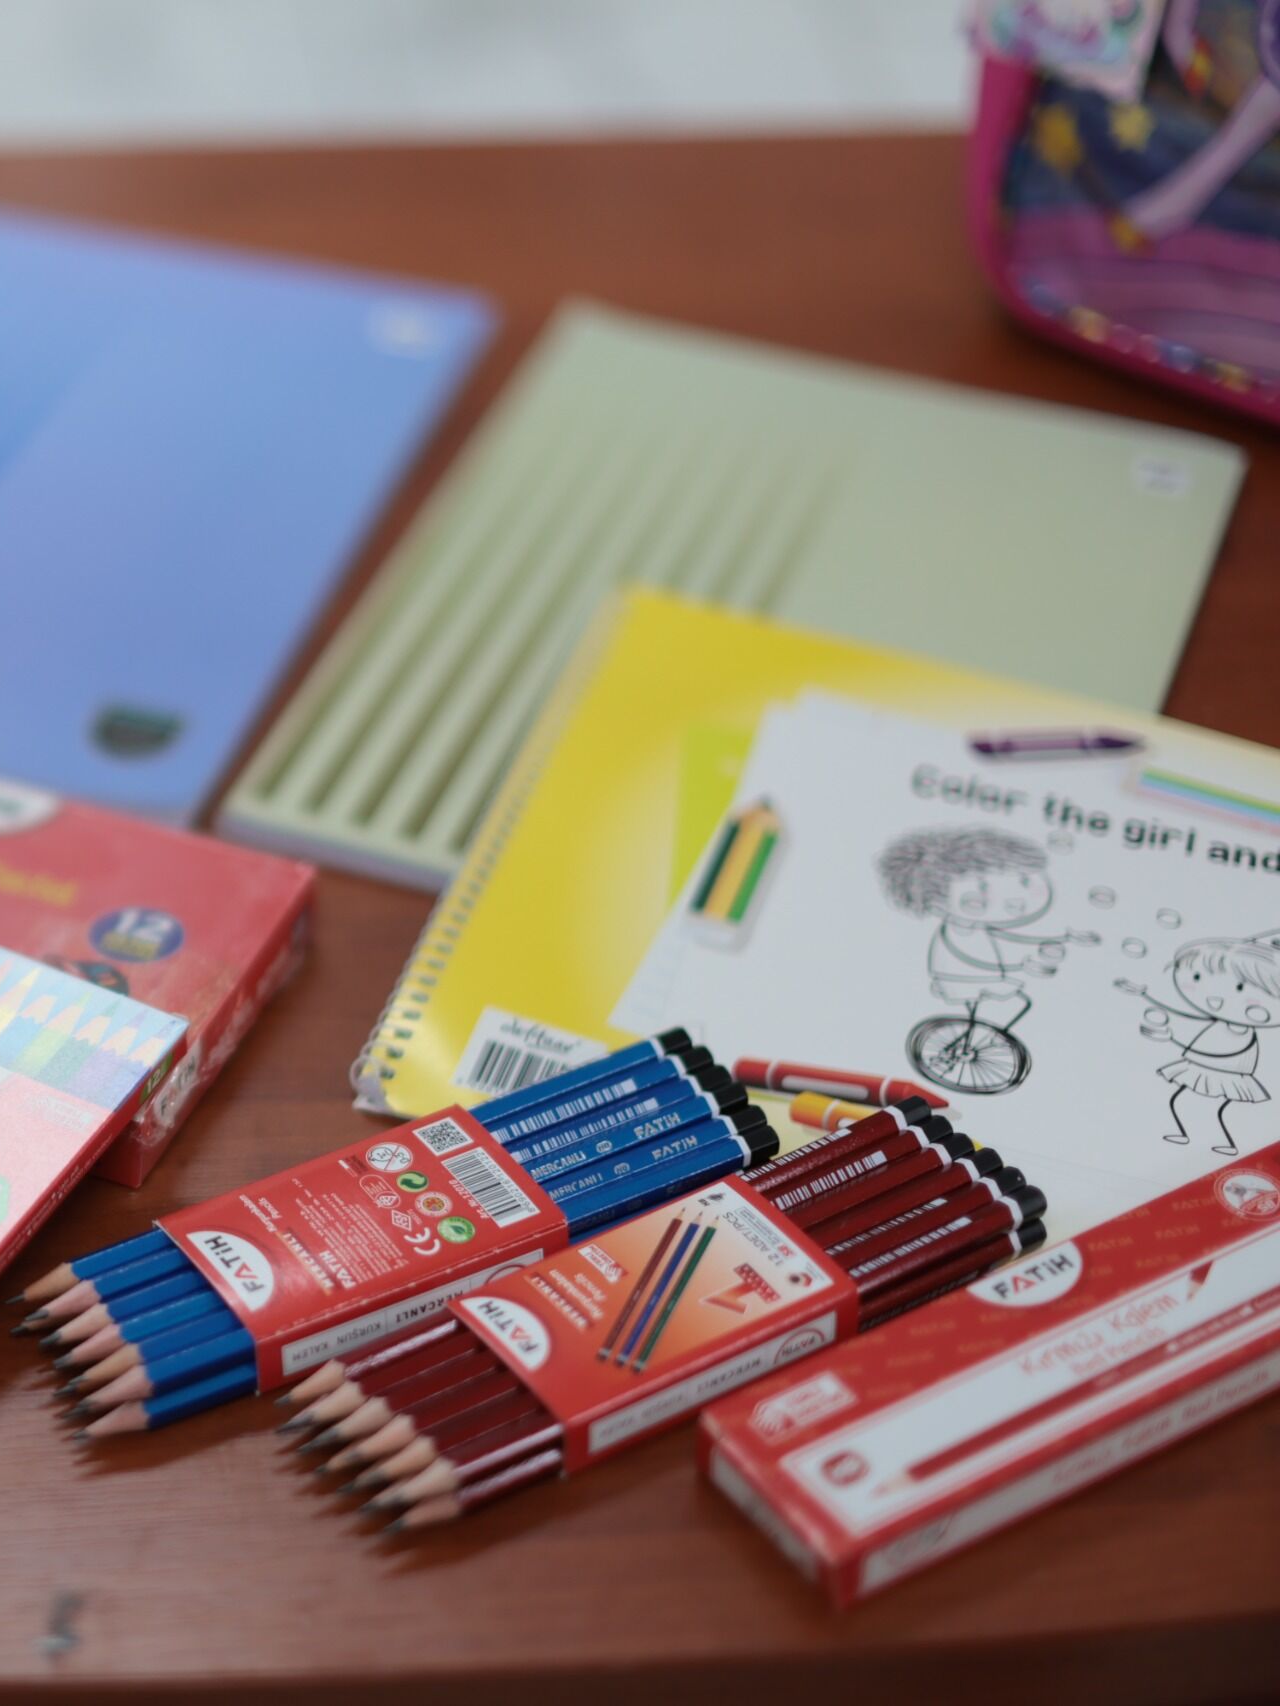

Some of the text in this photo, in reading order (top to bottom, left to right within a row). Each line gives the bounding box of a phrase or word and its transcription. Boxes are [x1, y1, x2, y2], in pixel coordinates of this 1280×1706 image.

[911, 766, 1280, 875] Color the girl and
[531, 1150, 587, 1180] MERCANLI
